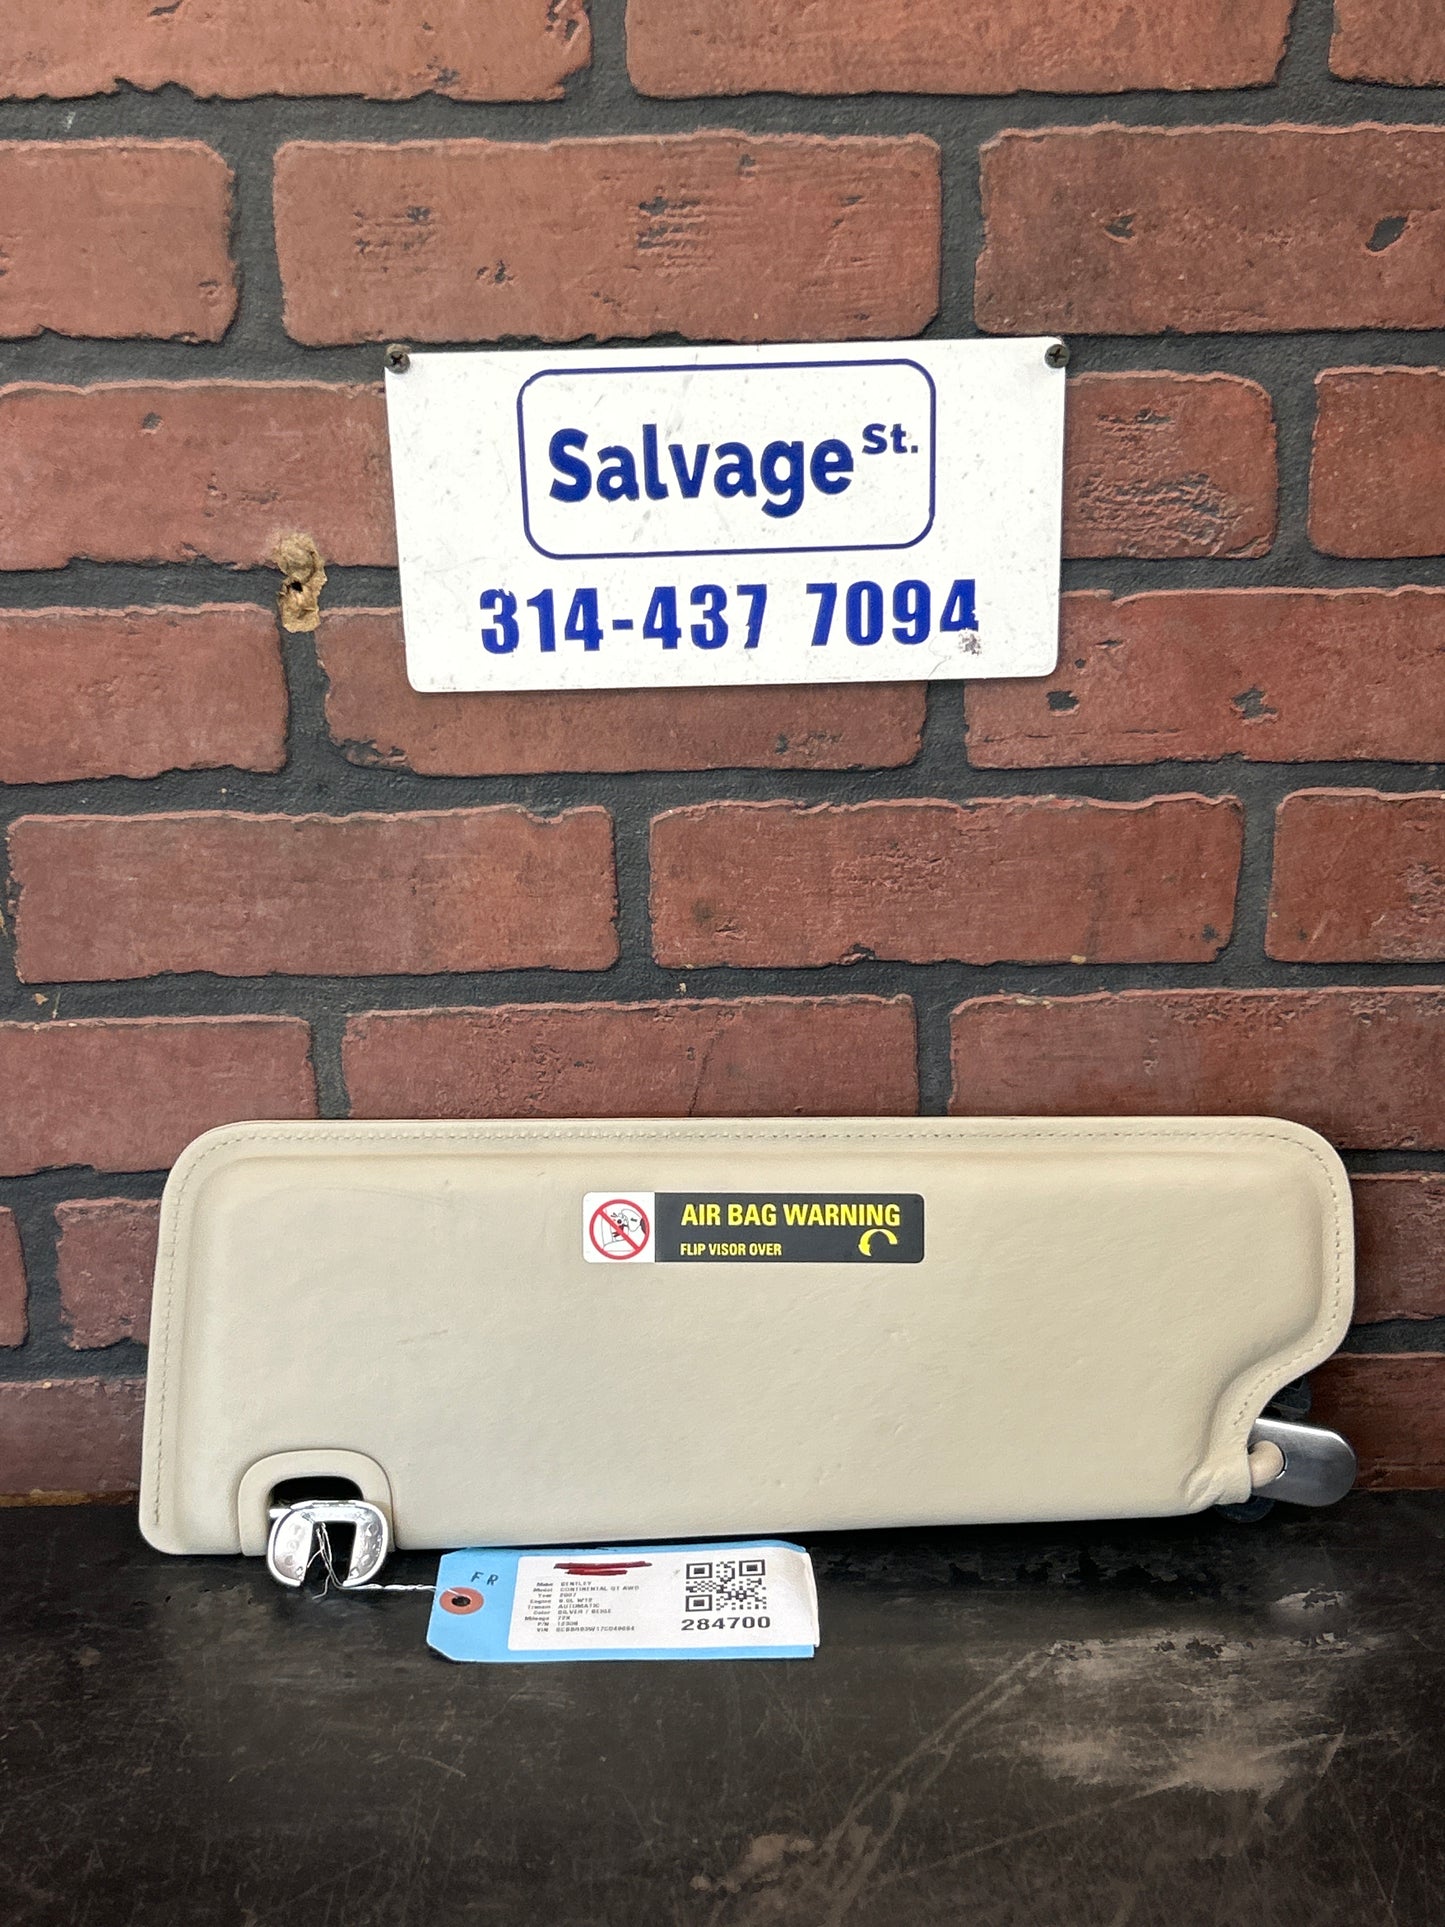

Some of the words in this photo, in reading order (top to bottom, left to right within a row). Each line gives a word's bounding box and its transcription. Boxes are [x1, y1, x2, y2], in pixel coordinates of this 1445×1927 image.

[548, 423, 855, 518] Salvage
[862, 423, 919, 456] St.
[480, 583, 769, 655] 314-437
[806, 578, 980, 648] 7094
[681, 1203, 721, 1226] AIR
[727, 1203, 777, 1226] BAG
[782, 1203, 901, 1226] WARNING
[680, 1243, 706, 1256] FLIP
[708, 1243, 746, 1256] VISOR
[748, 1243, 783, 1256] OVER
[680, 1615, 771, 1631] 284700
